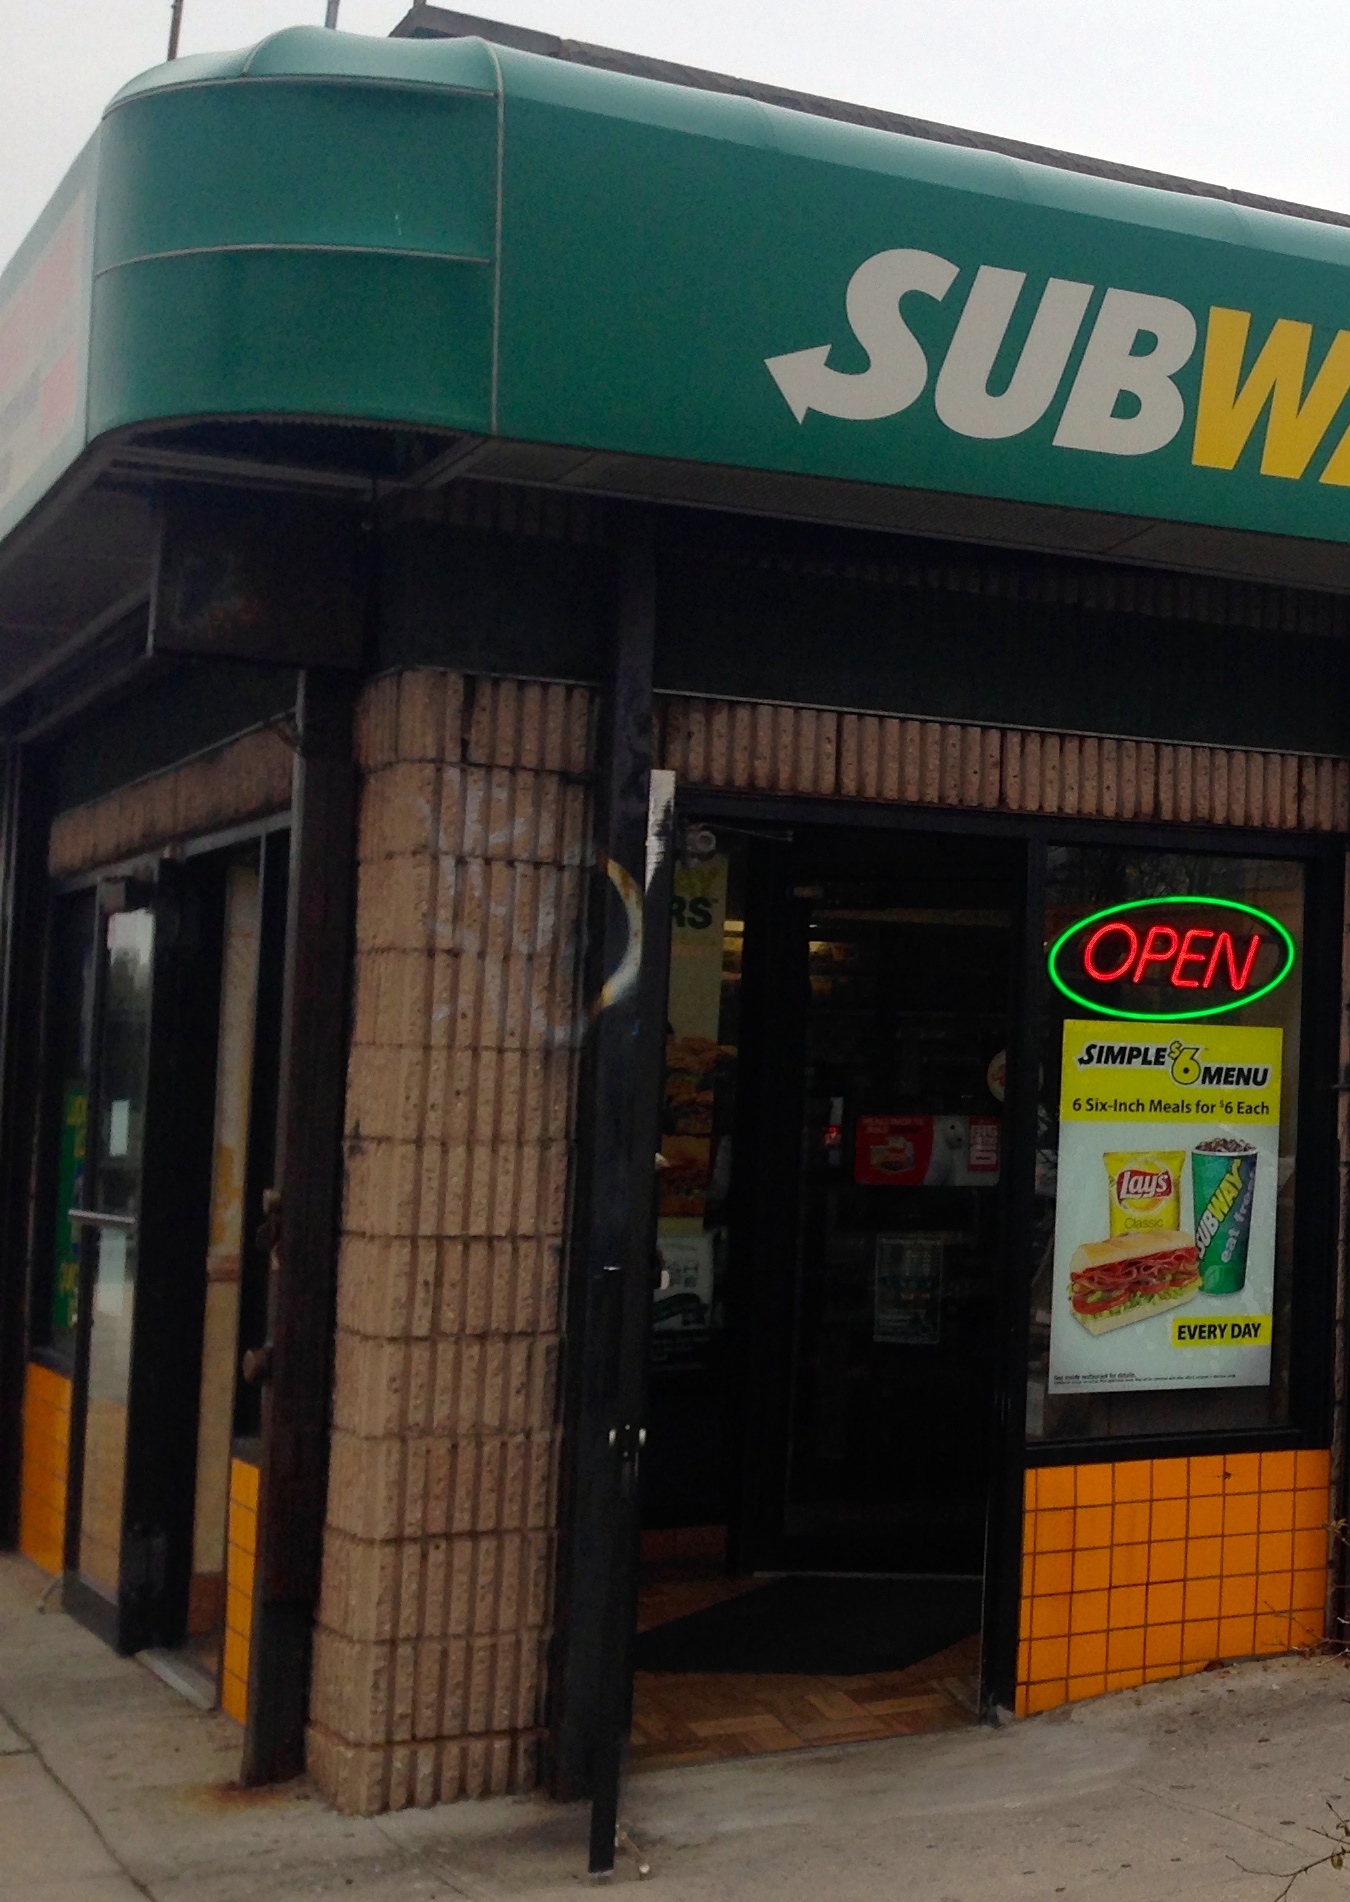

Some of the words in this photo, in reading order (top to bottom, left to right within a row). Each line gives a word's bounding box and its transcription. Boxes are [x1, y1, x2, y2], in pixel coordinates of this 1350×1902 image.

[1084, 922, 1260, 990] OPEN
[1077, 1043, 1168, 1067] SIMPLE
[1201, 1065, 1270, 1087] MENU
[1072, 1098, 1082, 1112] 6
[1085, 1098, 1145, 1113] Six-Inch
[1150, 1099, 1192, 1114] Meals
[1195, 1100, 1215, 1114] for
[1237, 1101, 1270, 1116] Each
[1124, 1217, 1165, 1230] Classic
[1196, 1158, 1244, 1260] SUBWAY
[1177, 1323, 1229, 1340] EVERY
[1230, 1323, 1262, 1339] DAY
